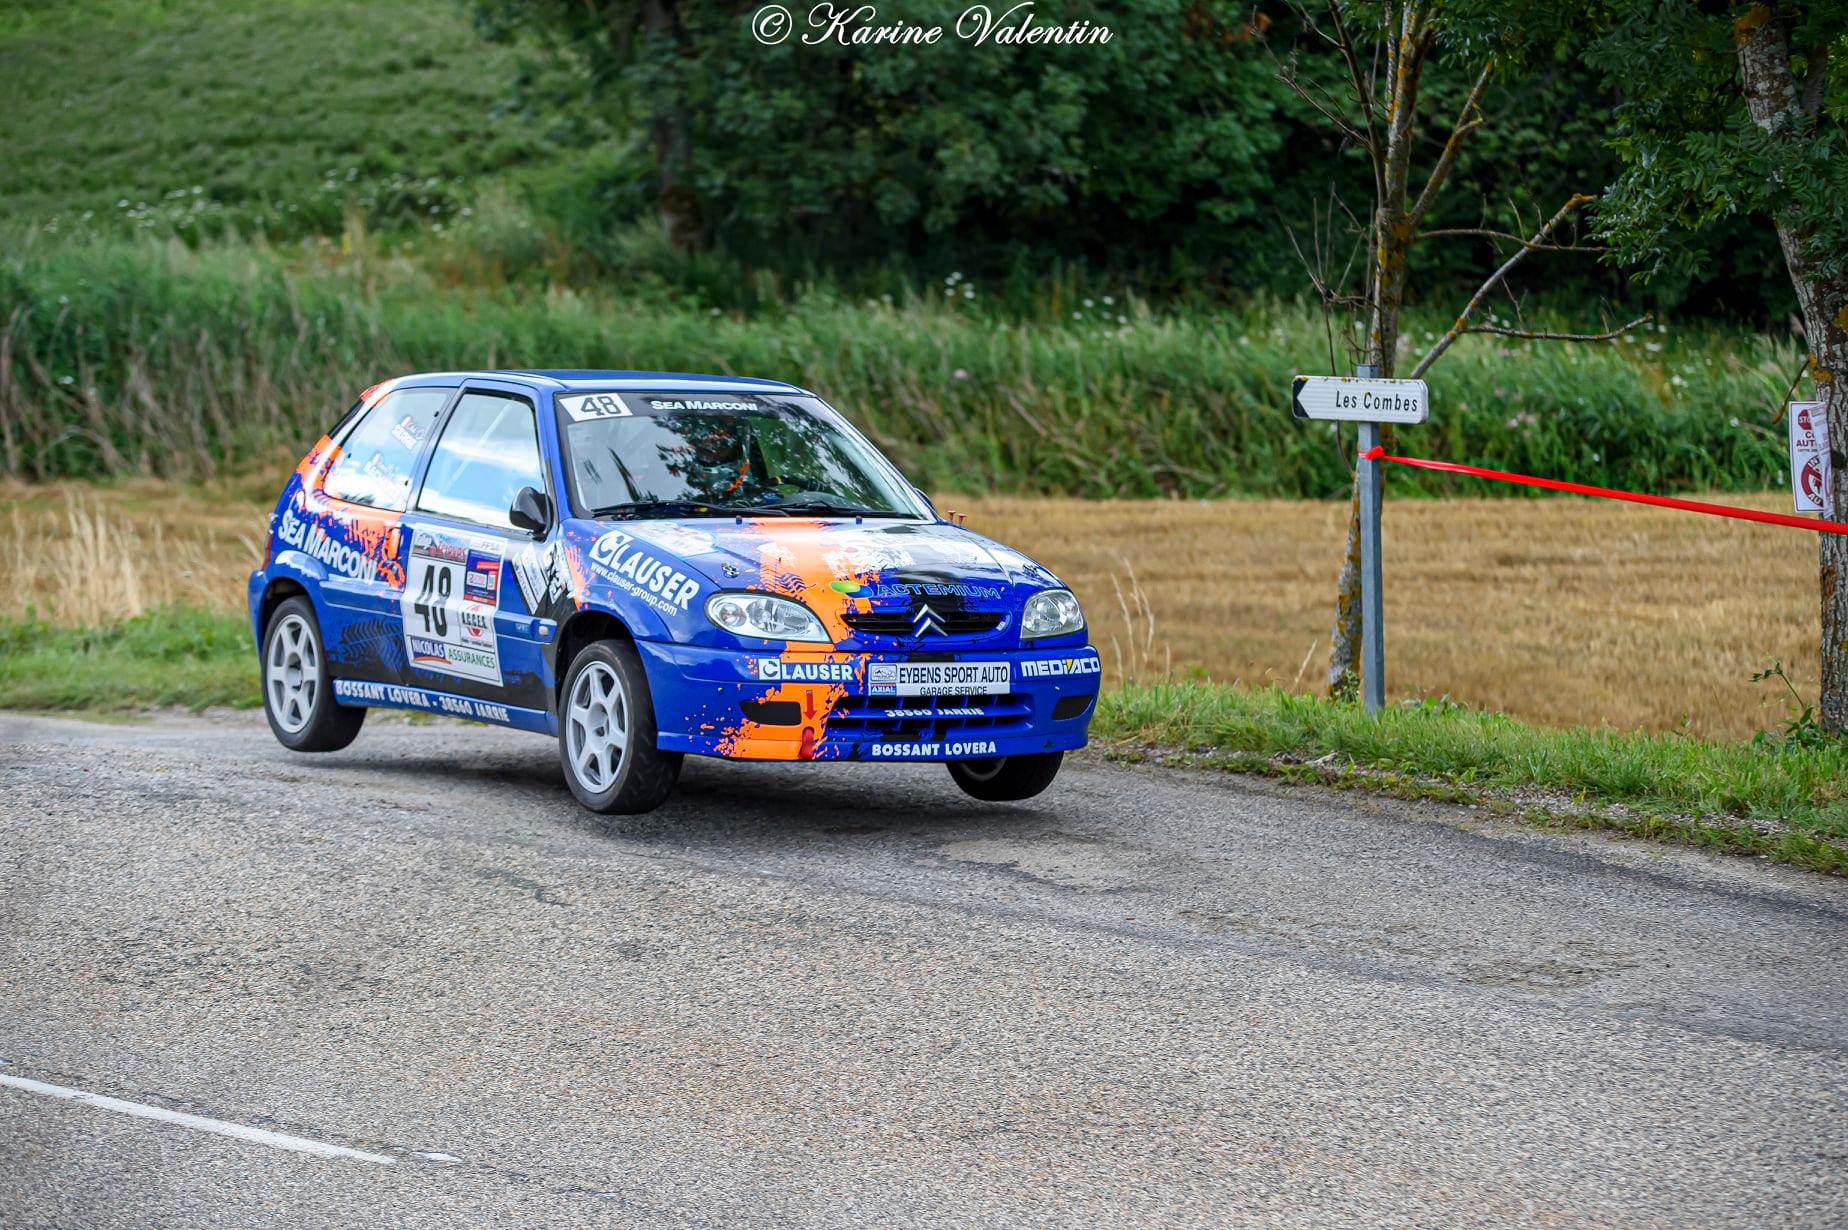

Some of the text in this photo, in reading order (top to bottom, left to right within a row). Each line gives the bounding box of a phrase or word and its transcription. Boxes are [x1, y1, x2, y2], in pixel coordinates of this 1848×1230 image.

[580, 395, 622, 416] 48
[651, 400, 759, 411] SEA MARCONI
[1335, 391, 1418, 412] Les Combes
[278, 509, 307, 549] SEA
[303, 523, 378, 585] MARCONI
[589, 530, 700, 610] CLAUSER
[590, 562, 678, 616] www.clauser-group.com
[877, 583, 1001, 599] ACTEMIUM
[412, 639, 445, 658] NICOLAS
[448, 648, 496, 669] ASSURANCES
[760, 660, 853, 680] CLAUSER
[900, 666, 1008, 683] EYBENS SPORT AUTO
[335, 680, 386, 700] BOSSANT
[387, 687, 431, 707] LOVERA
[474, 703, 511, 722] JARRIE
[920, 686, 988, 696] GARAGE SERVICE
[872, 741, 997, 757] BOSSANT LOVERA
